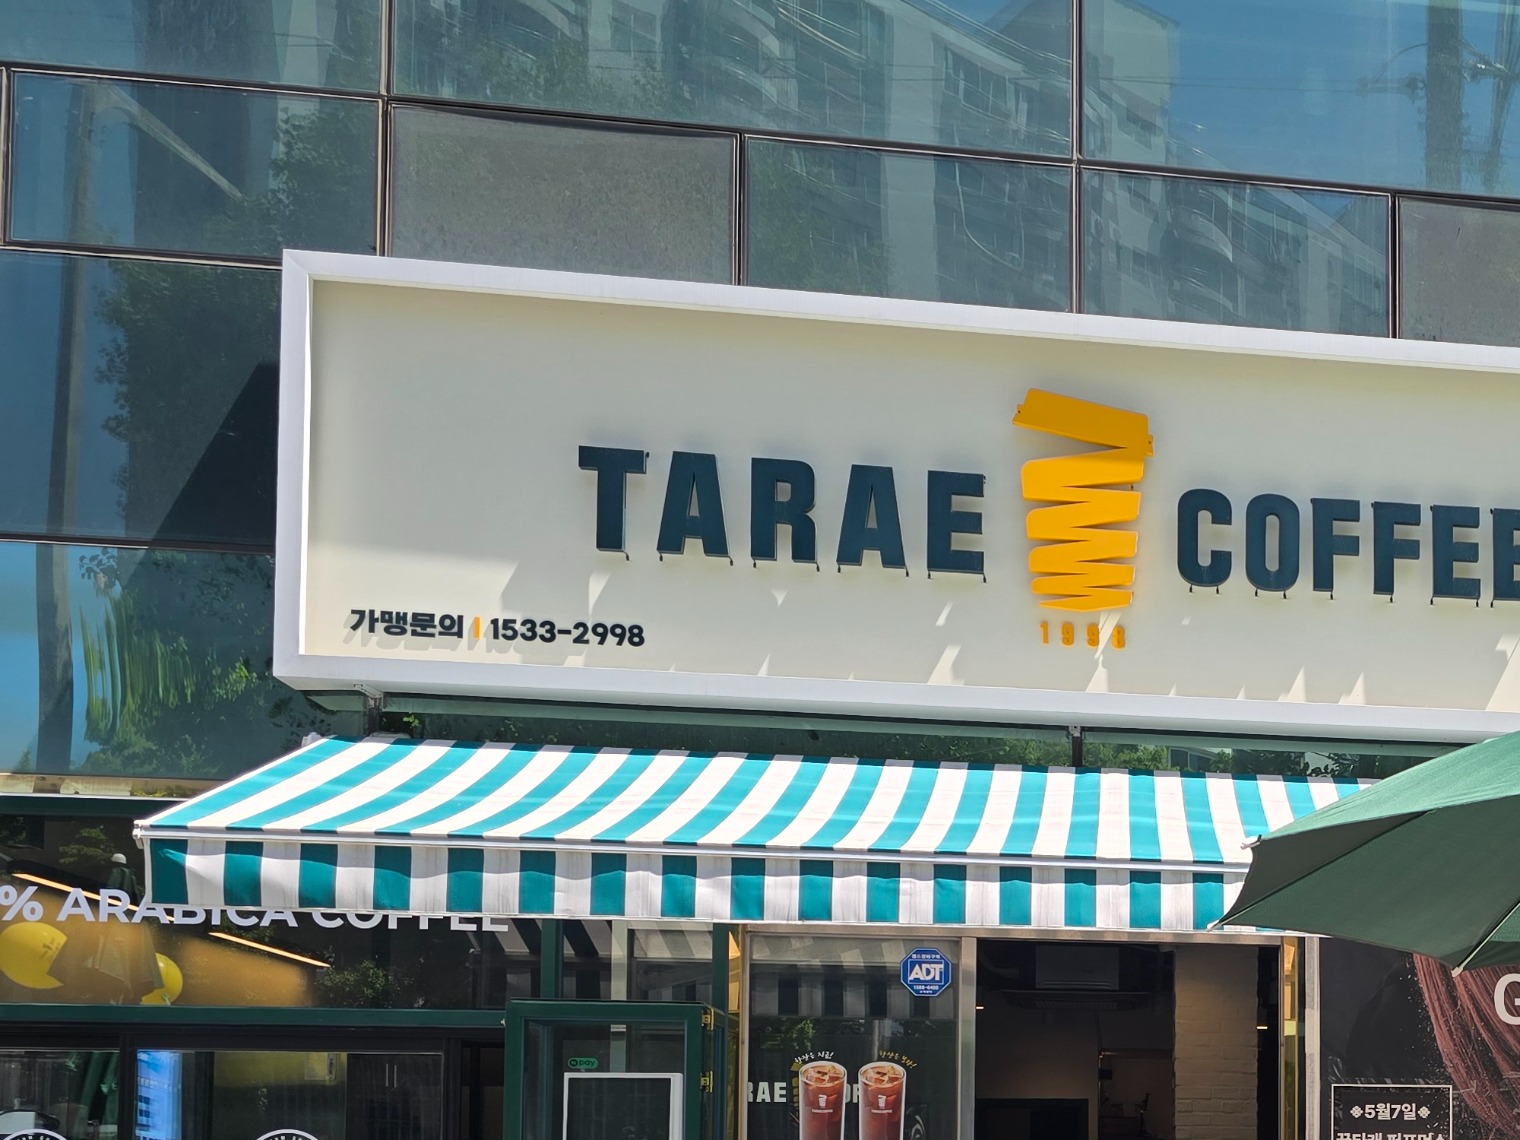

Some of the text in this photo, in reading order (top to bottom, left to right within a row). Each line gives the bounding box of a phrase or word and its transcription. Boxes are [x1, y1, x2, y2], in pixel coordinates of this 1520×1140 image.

[578, 445, 986, 576] TARAE
[350, 608, 645, 648] 가맹문의 1533-2998
[1039, 620, 1127, 650] 1998
[909, 963, 944, 981] ADT
